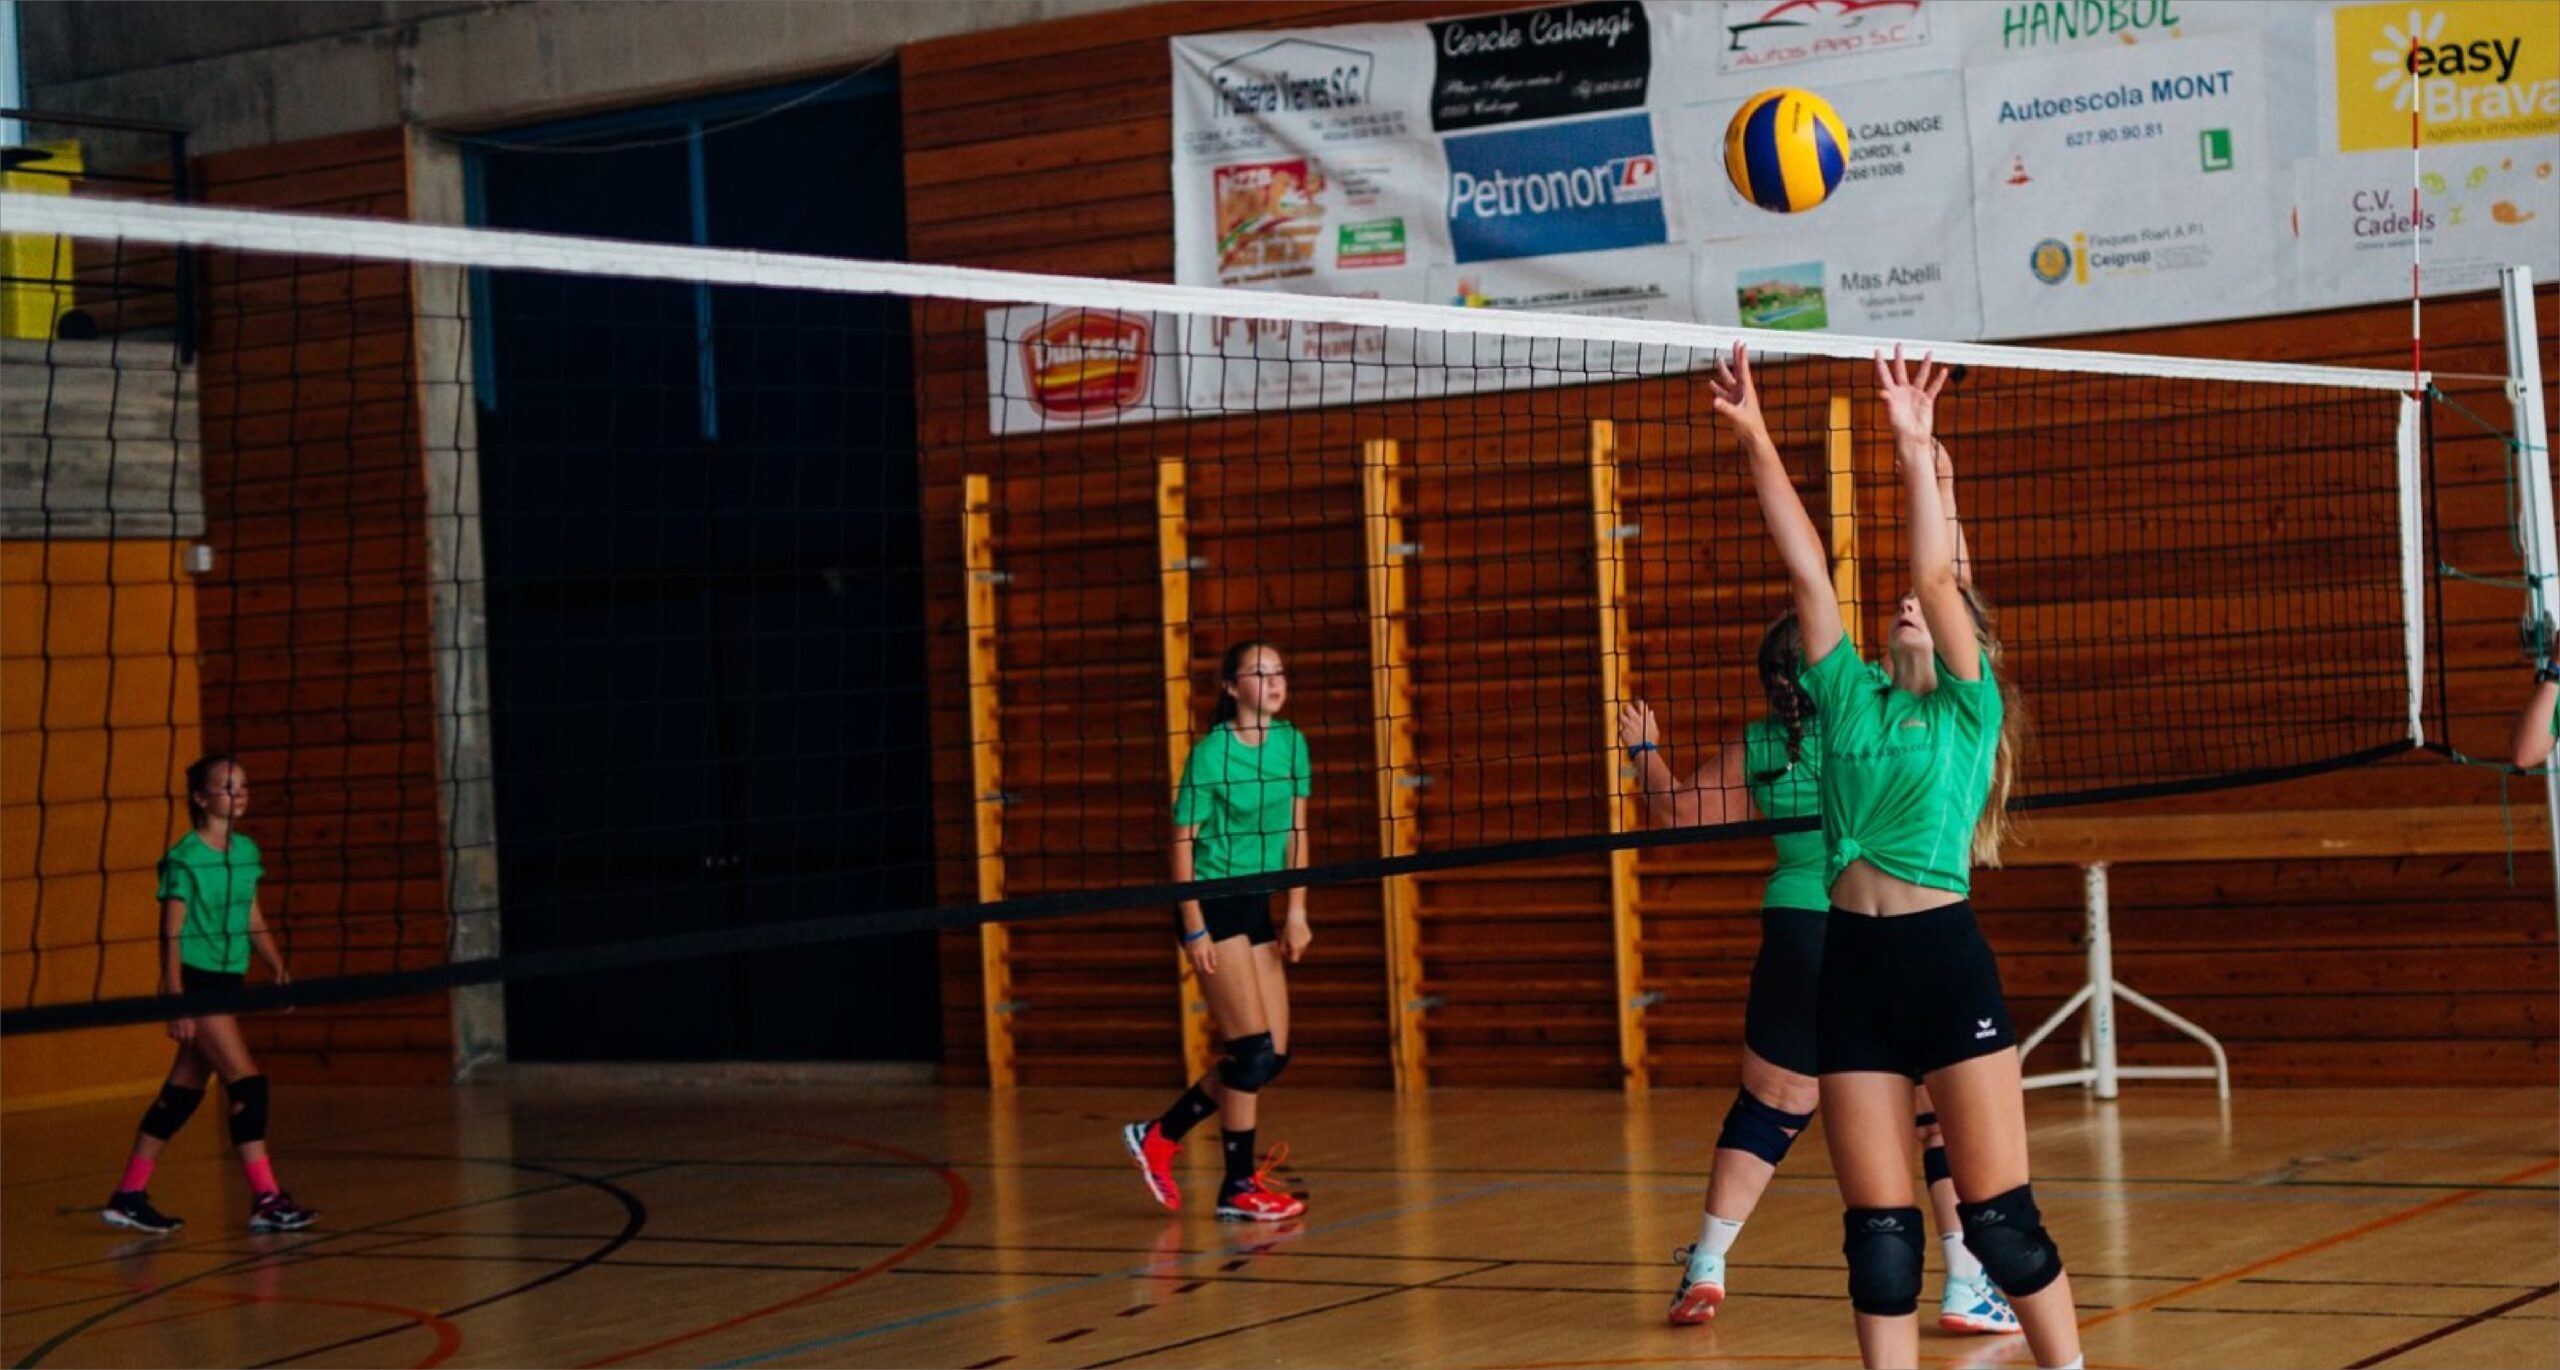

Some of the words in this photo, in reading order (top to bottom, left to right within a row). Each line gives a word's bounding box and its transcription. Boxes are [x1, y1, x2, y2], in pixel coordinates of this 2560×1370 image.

[1444, 18, 1522, 56] Cercle
[1529, 7, 1634, 48] Calongi
[2406, 37, 2521, 83] easy
[1998, 85, 2144, 124] Autoescola
[2151, 70, 2234, 103] MONT
[2425, 78, 2560, 122] Brava
[1859, 114, 1945, 140] CALONGE
[2065, 122, 2163, 147] 627.90.90.81
[1451, 164, 1612, 219] Petronor
[2353, 190, 2394, 213] C.V.
[2090, 249, 2151, 268] Ceigrup
[1840, 272, 1882, 291] Mas
